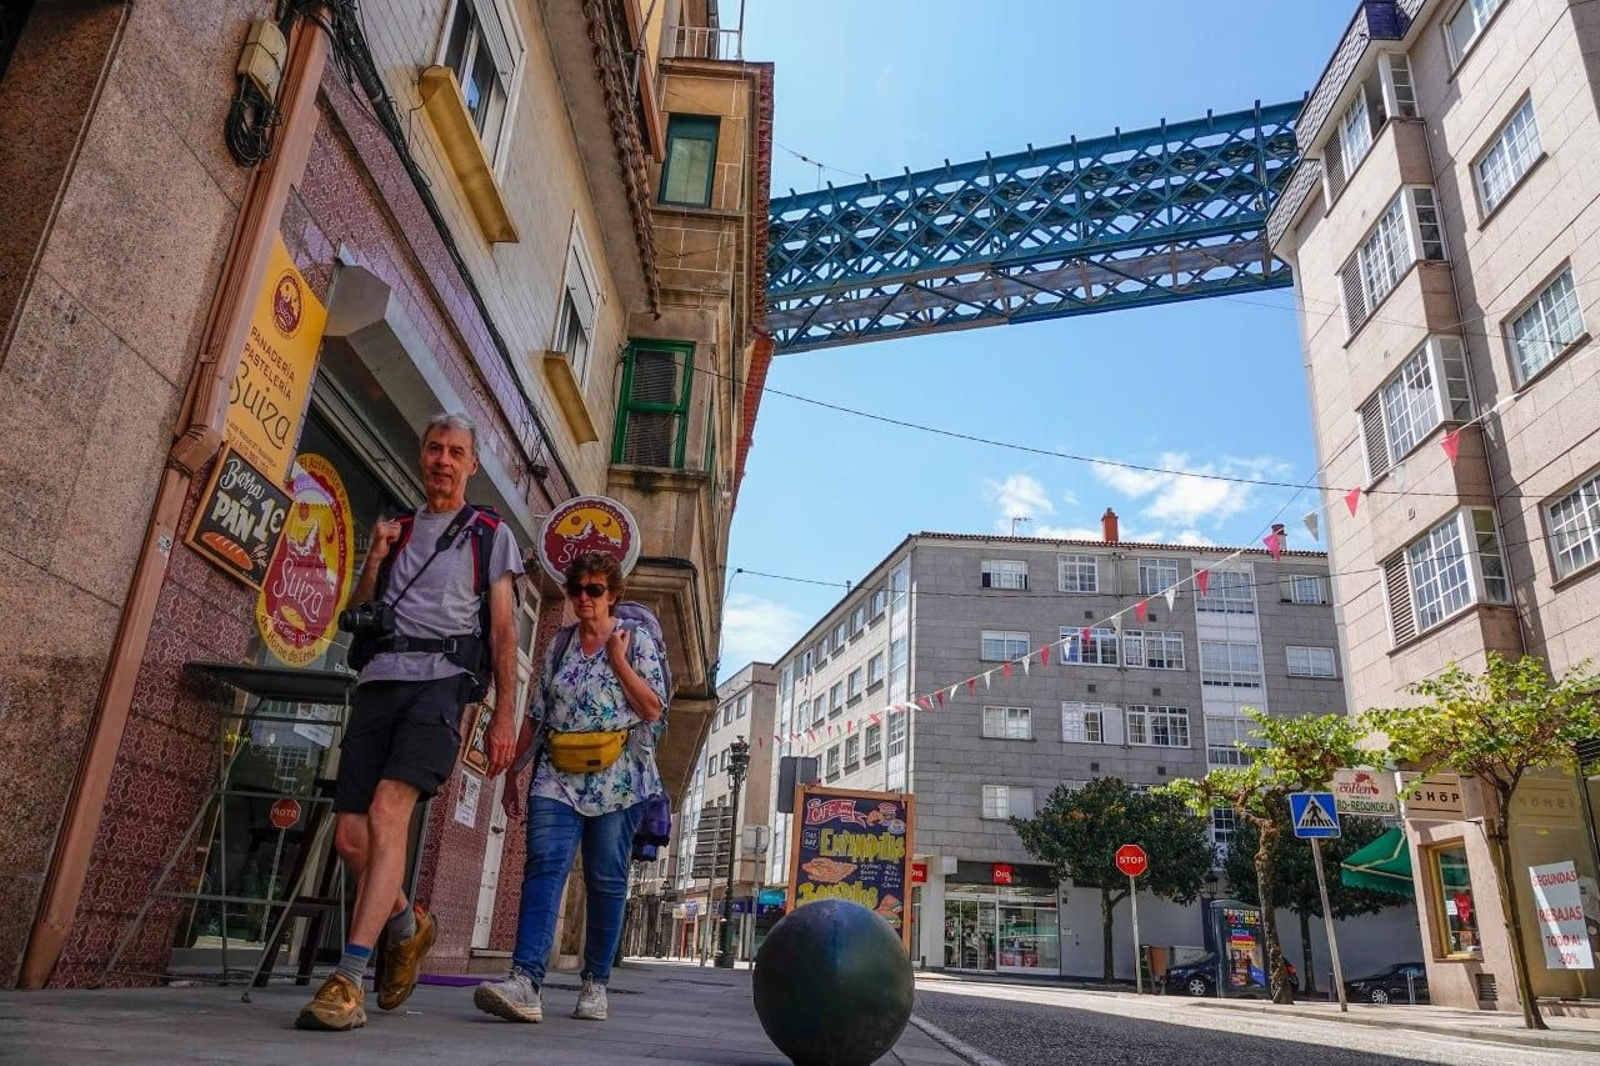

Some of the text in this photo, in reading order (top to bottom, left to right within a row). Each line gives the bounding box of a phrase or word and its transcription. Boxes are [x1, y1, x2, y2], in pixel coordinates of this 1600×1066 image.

[230, 360, 292, 450] Suiza
[211, 490, 256, 541] PAN
[253, 498, 285, 541] 1€
[273, 557, 323, 623] Suiza
[1119, 856, 1144, 865] STOP
[1532, 871, 1577, 887] SEGUNDAS
[1539, 906, 1582, 922] REBAJAS
[1546, 934, 1582, 947] TODO AL
